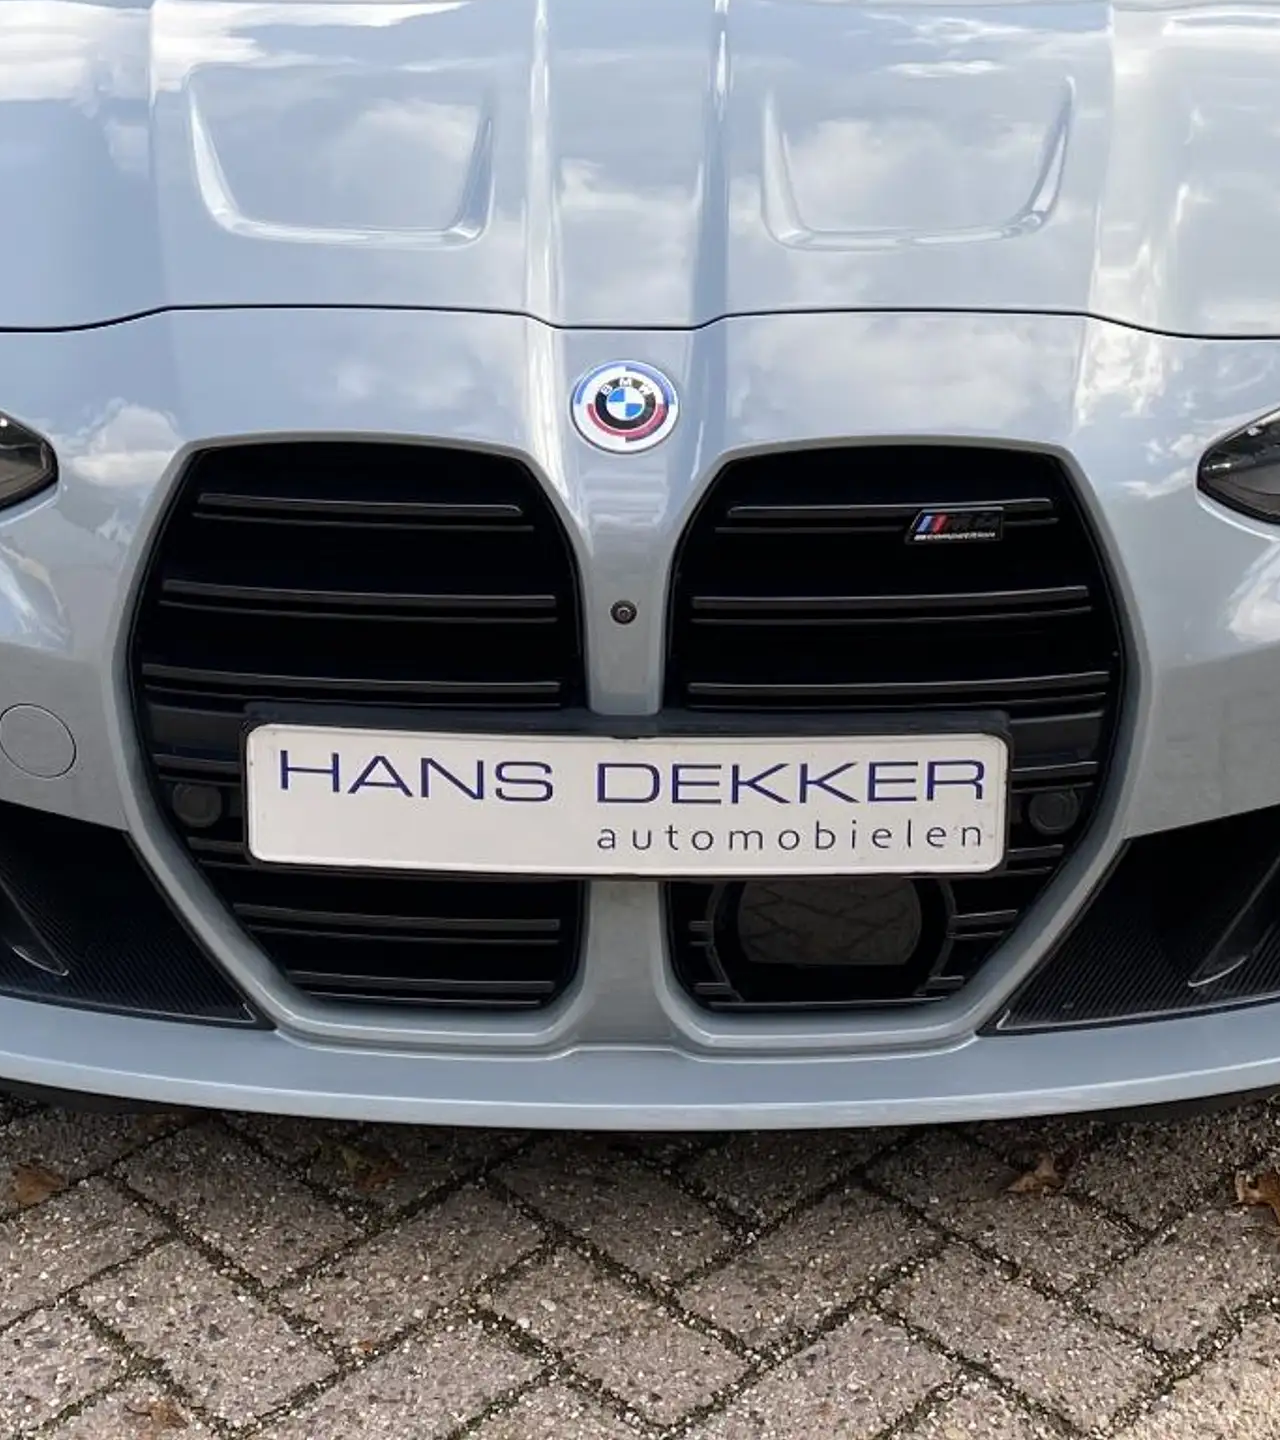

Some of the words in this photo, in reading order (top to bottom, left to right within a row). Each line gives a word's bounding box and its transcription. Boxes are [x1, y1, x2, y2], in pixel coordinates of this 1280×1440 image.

[279, 749, 554, 803] HANS
[596, 759, 986, 805] DEKKER
[596, 819, 982, 851] automobielen
